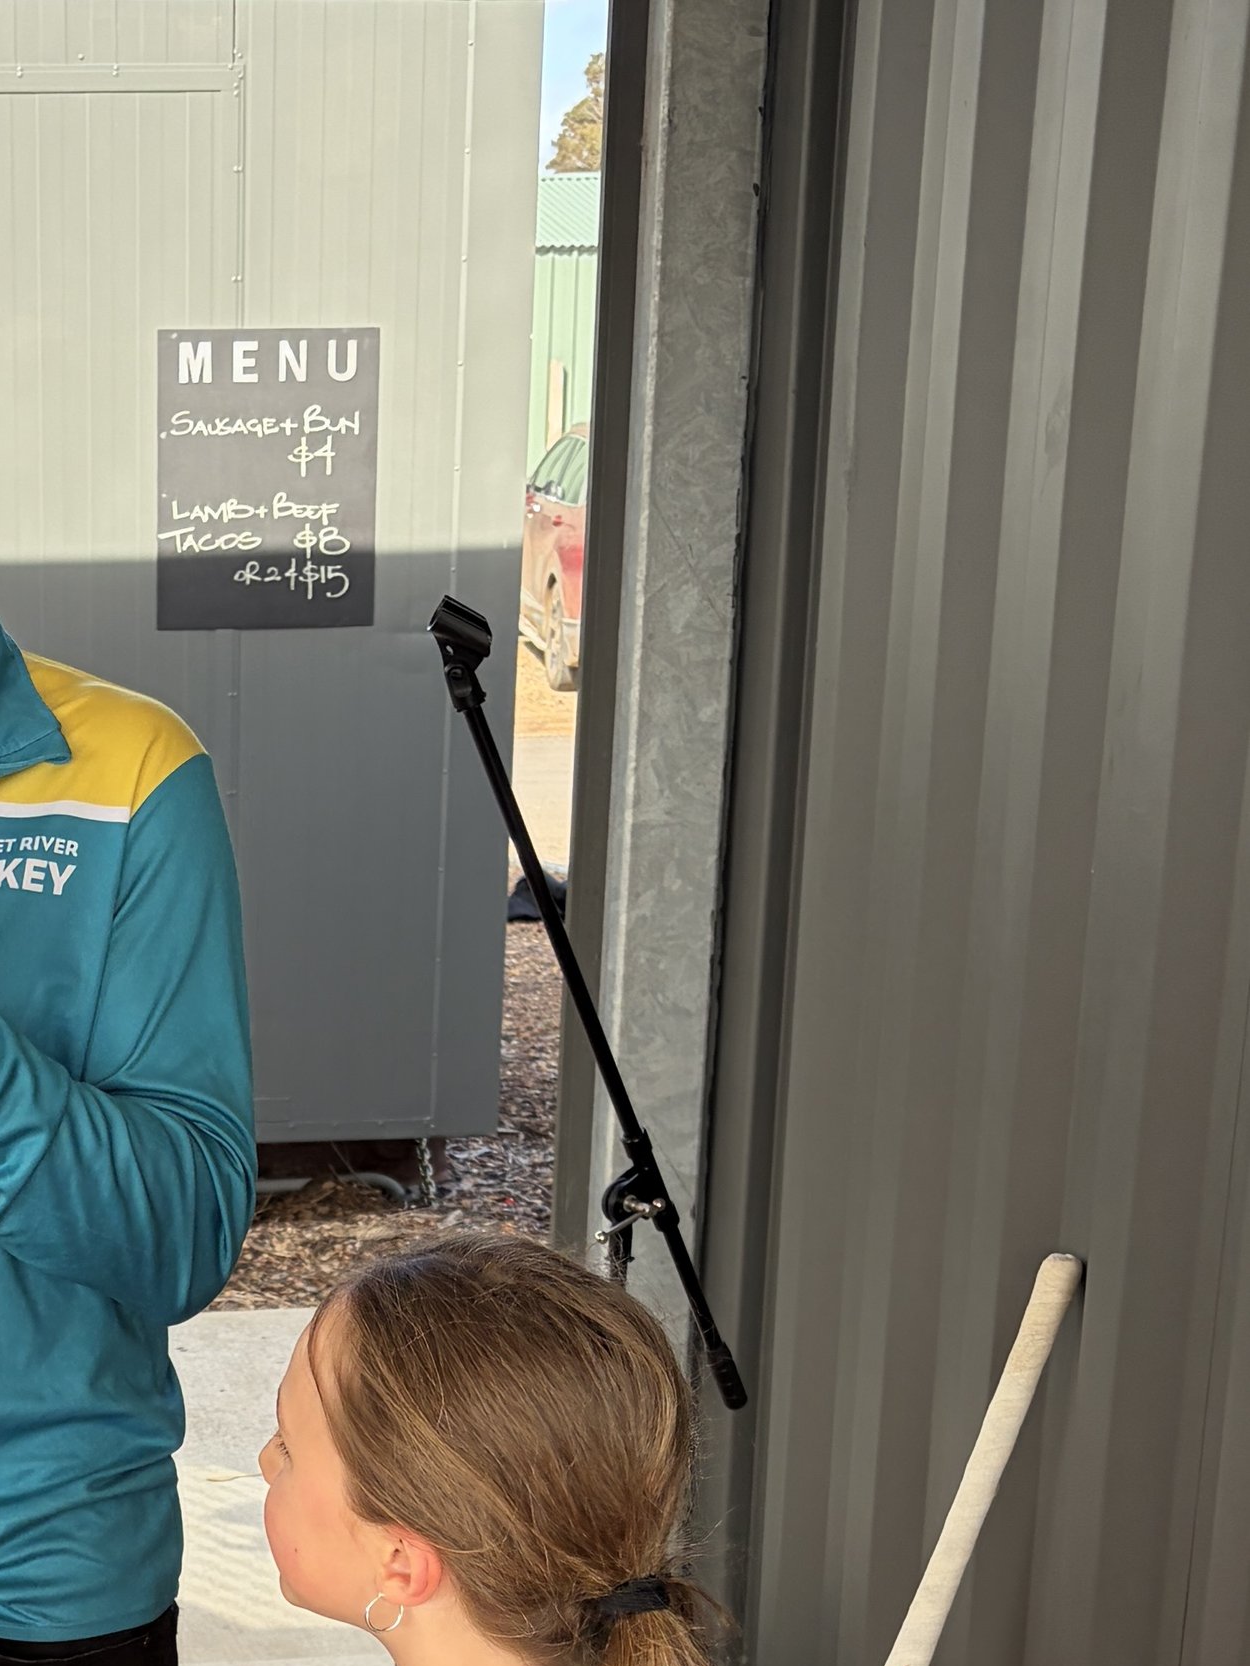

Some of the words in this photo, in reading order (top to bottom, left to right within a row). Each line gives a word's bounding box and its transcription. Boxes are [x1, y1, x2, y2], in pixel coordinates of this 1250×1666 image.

[178, 339, 358, 384] MENU
[303, 404, 360, 435] BUN
[287, 434, 336, 477] $4
[273, 491, 340, 526] BEEF
[158, 526, 262, 553] TACOS
[293, 523, 351, 559] $8
[298, 561, 350, 600] $15
[19, 835, 79, 857] RIVER
